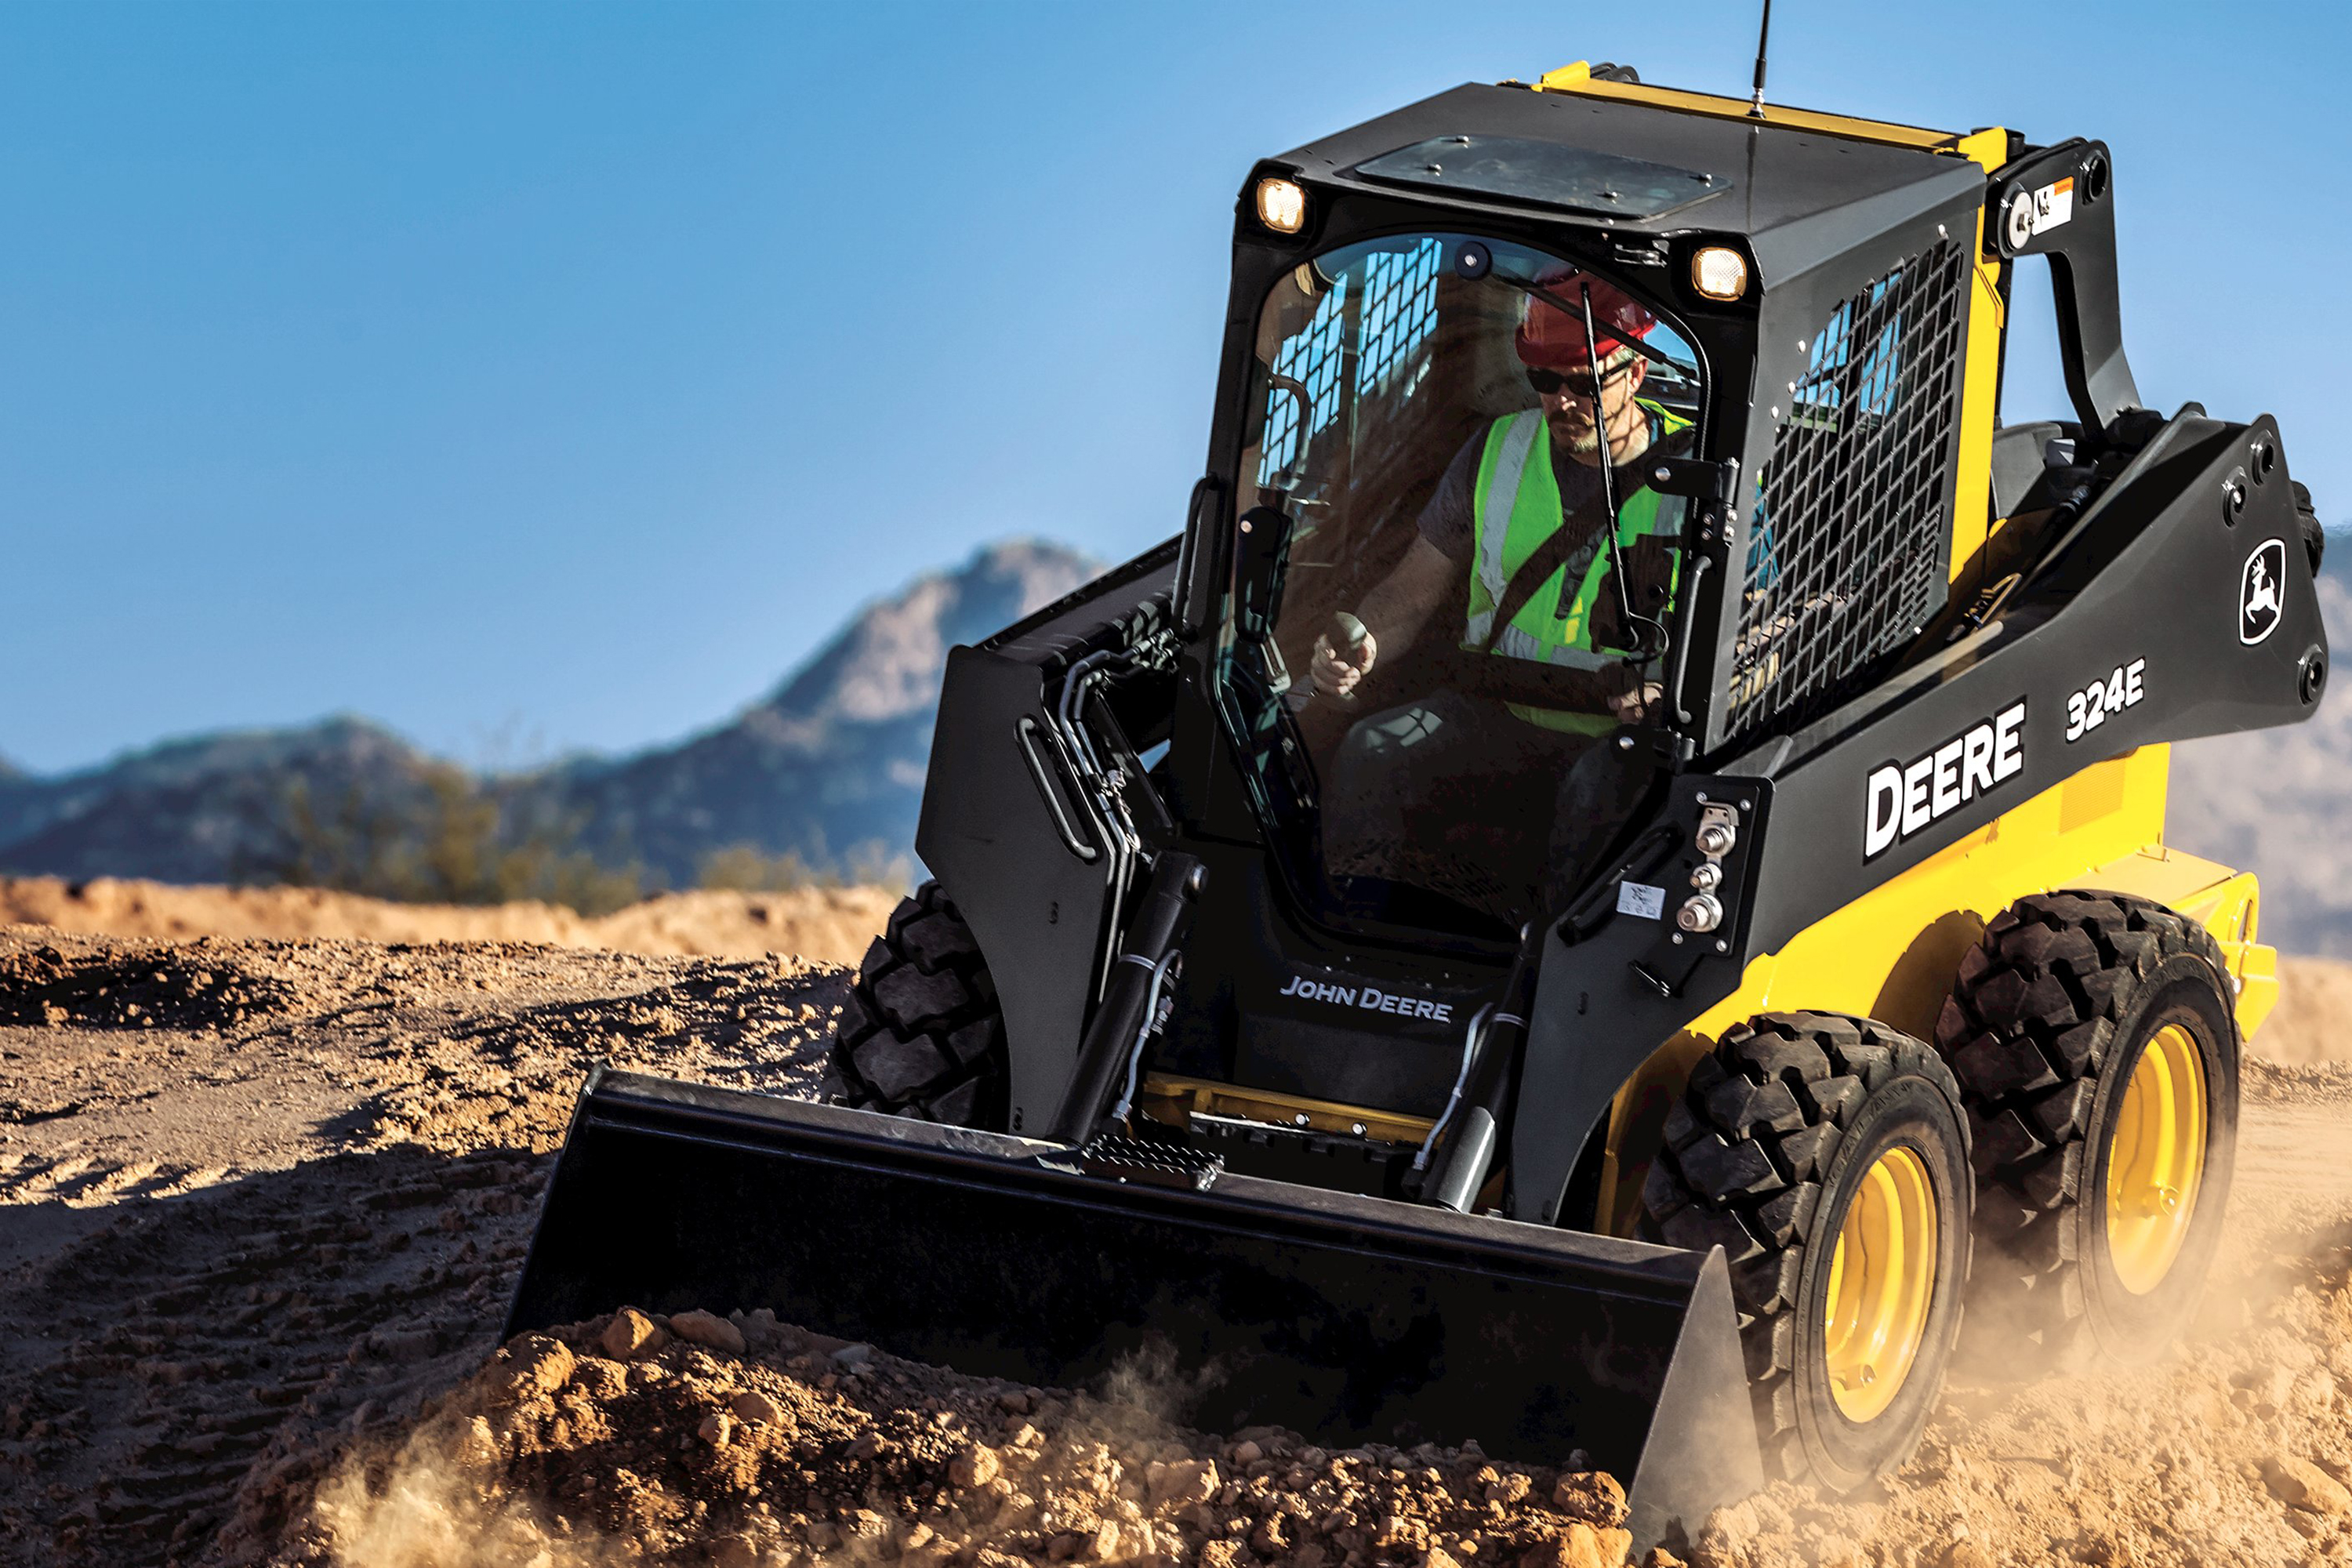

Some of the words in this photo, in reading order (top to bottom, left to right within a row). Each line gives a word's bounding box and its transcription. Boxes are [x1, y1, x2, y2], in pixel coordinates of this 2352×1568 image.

[2066, 657, 2145, 742] 324E
[1864, 702, 2025, 858] DEERE
[1279, 975, 1356, 1007] JOHN
[1359, 986, 1453, 1022] DEERE
